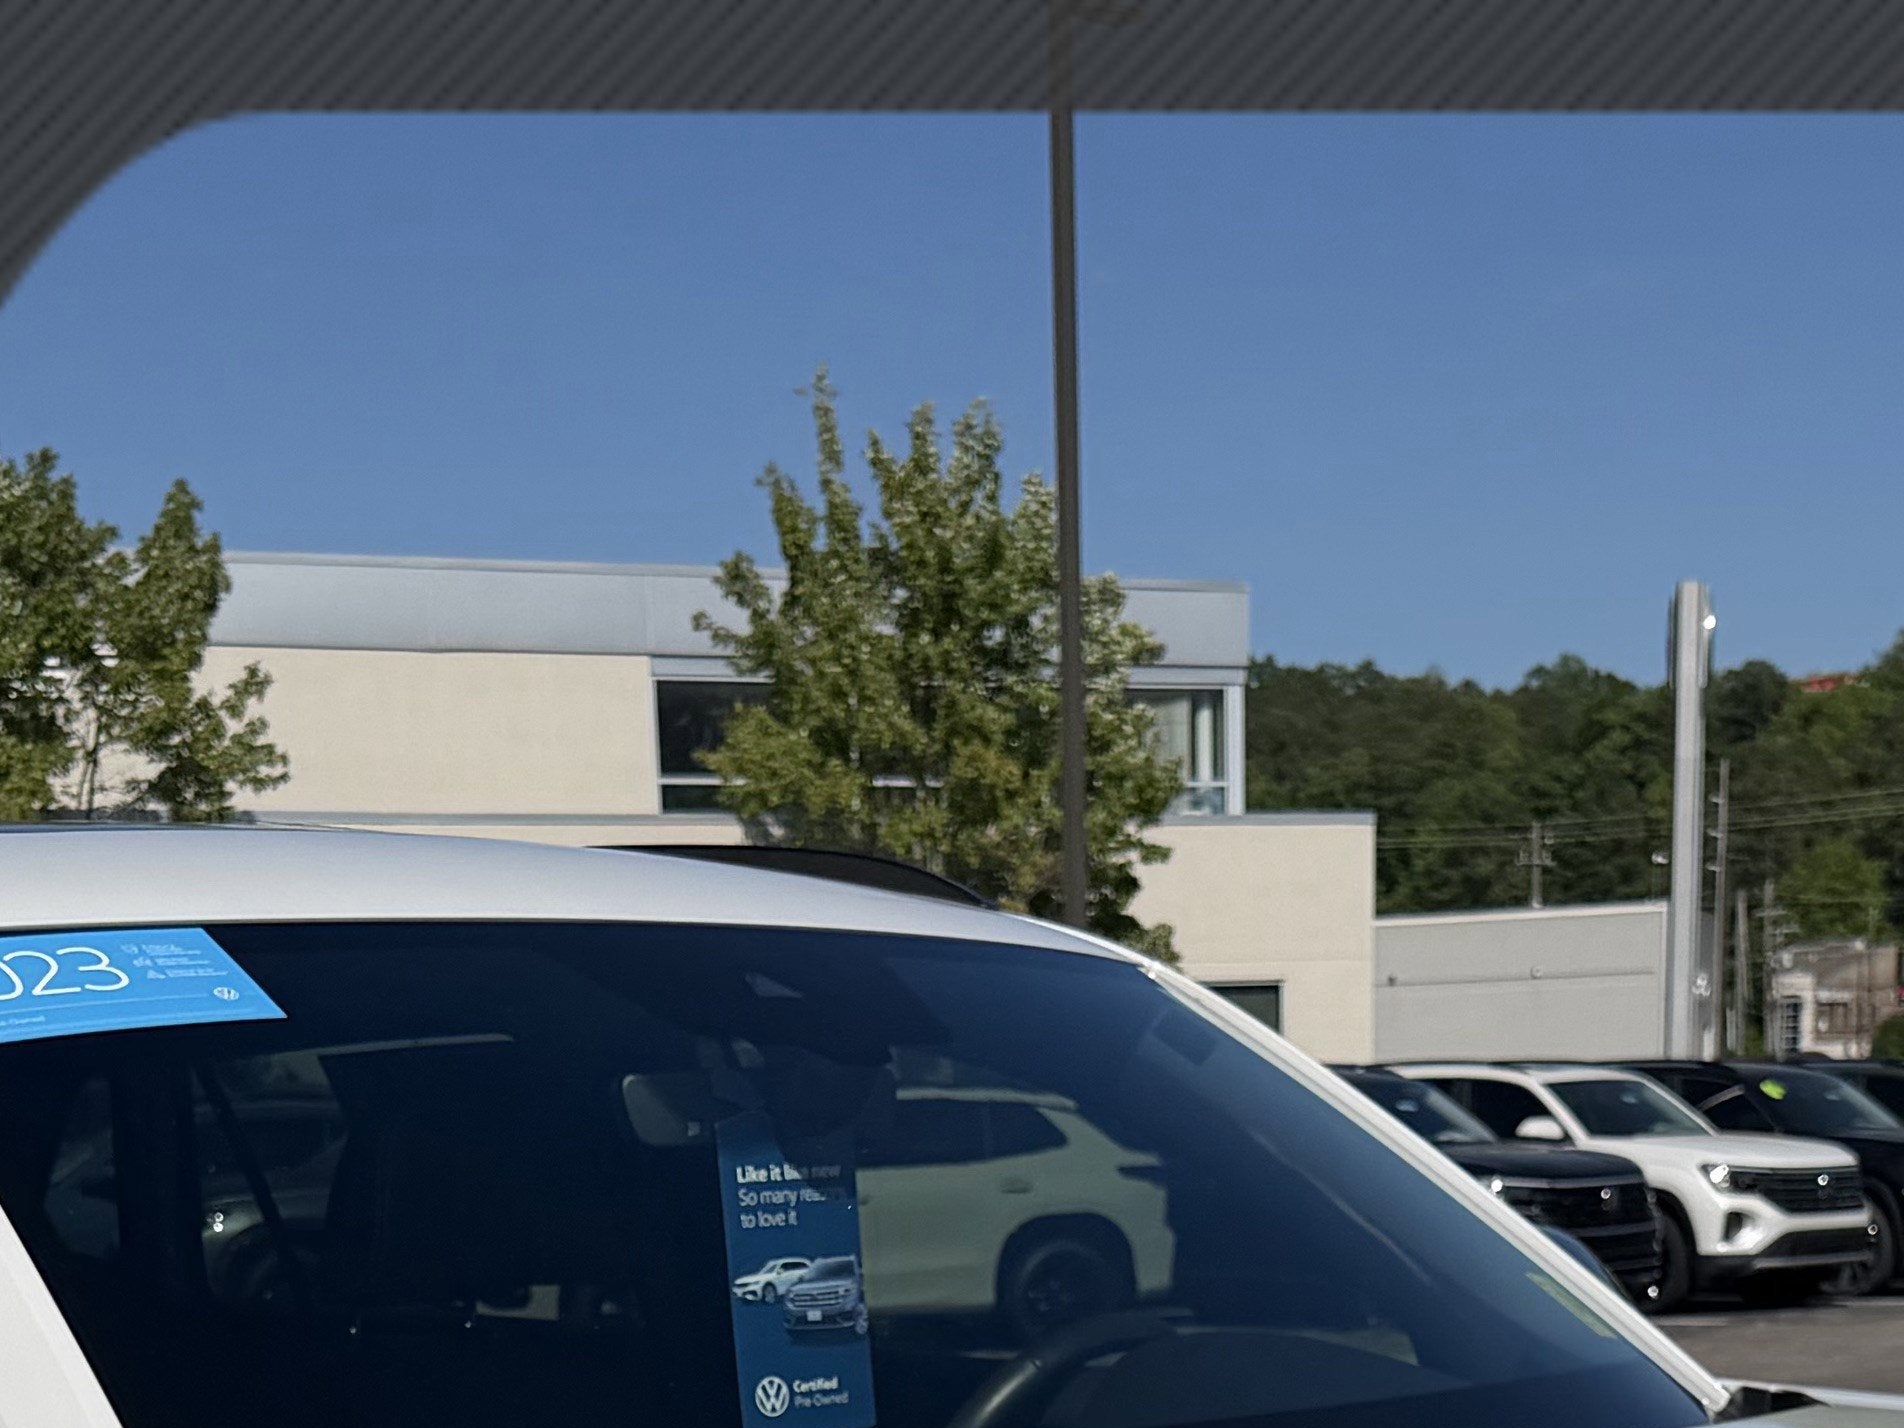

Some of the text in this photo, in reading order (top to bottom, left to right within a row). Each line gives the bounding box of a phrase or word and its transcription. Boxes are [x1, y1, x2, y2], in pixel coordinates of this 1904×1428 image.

[738, 1187, 757, 1206] So
[759, 1190, 798, 1207] many
[757, 1210, 786, 1227] love
